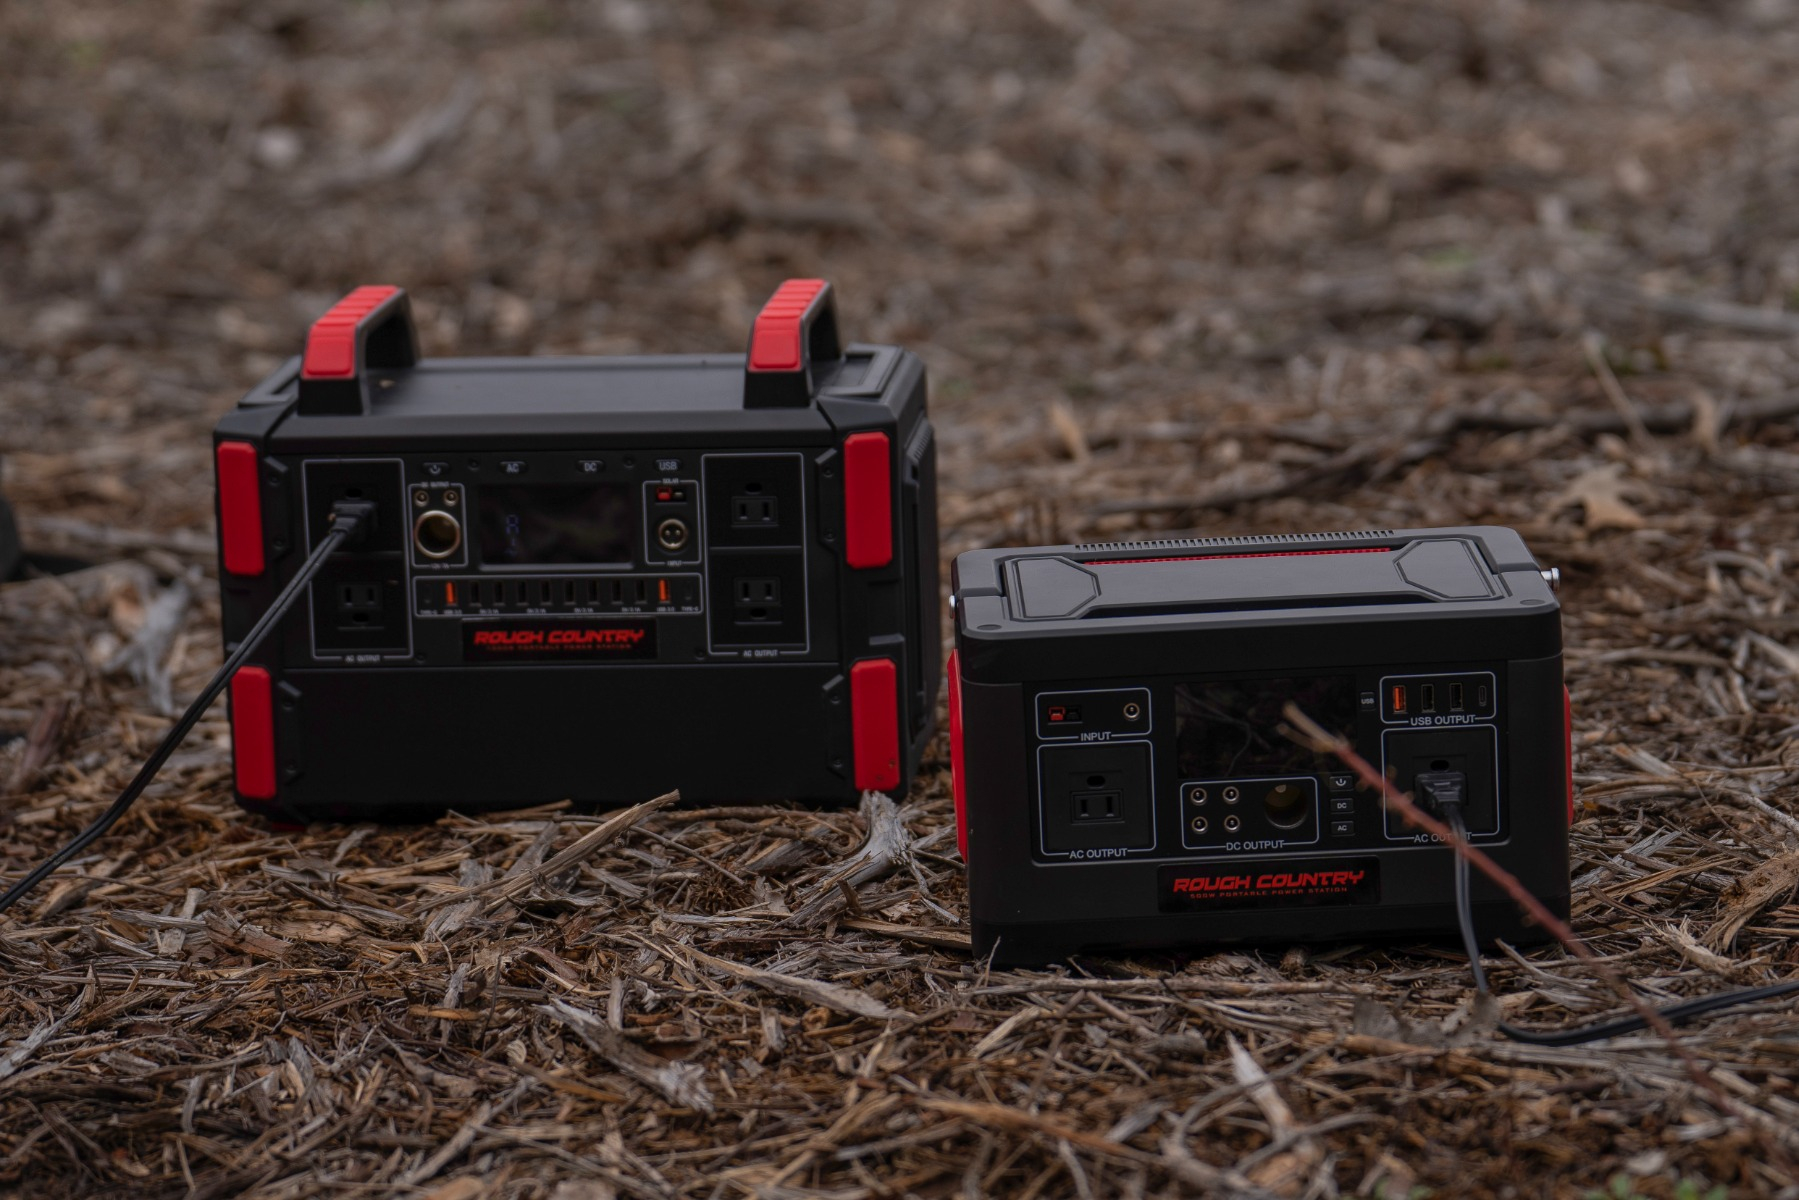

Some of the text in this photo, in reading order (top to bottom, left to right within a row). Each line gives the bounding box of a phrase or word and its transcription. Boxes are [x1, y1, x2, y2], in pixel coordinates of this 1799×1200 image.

[504, 463, 518, 474] AC
[584, 462, 598, 472] DC
[658, 461, 678, 471] USB
[473, 629, 643, 645] ROUGH COUNTRY
[755, 649, 778, 657] OUTPUT
[1410, 714, 1475, 726] USB OUTPUT
[1080, 731, 1111, 742] INPUT
[1413, 831, 1472, 843] AC OUTT
[1226, 840, 1284, 851] DC OUTPUT
[1069, 848, 1128, 860] AC OUTPUT
[1173, 870, 1365, 892] ROUGH COUNTRY
